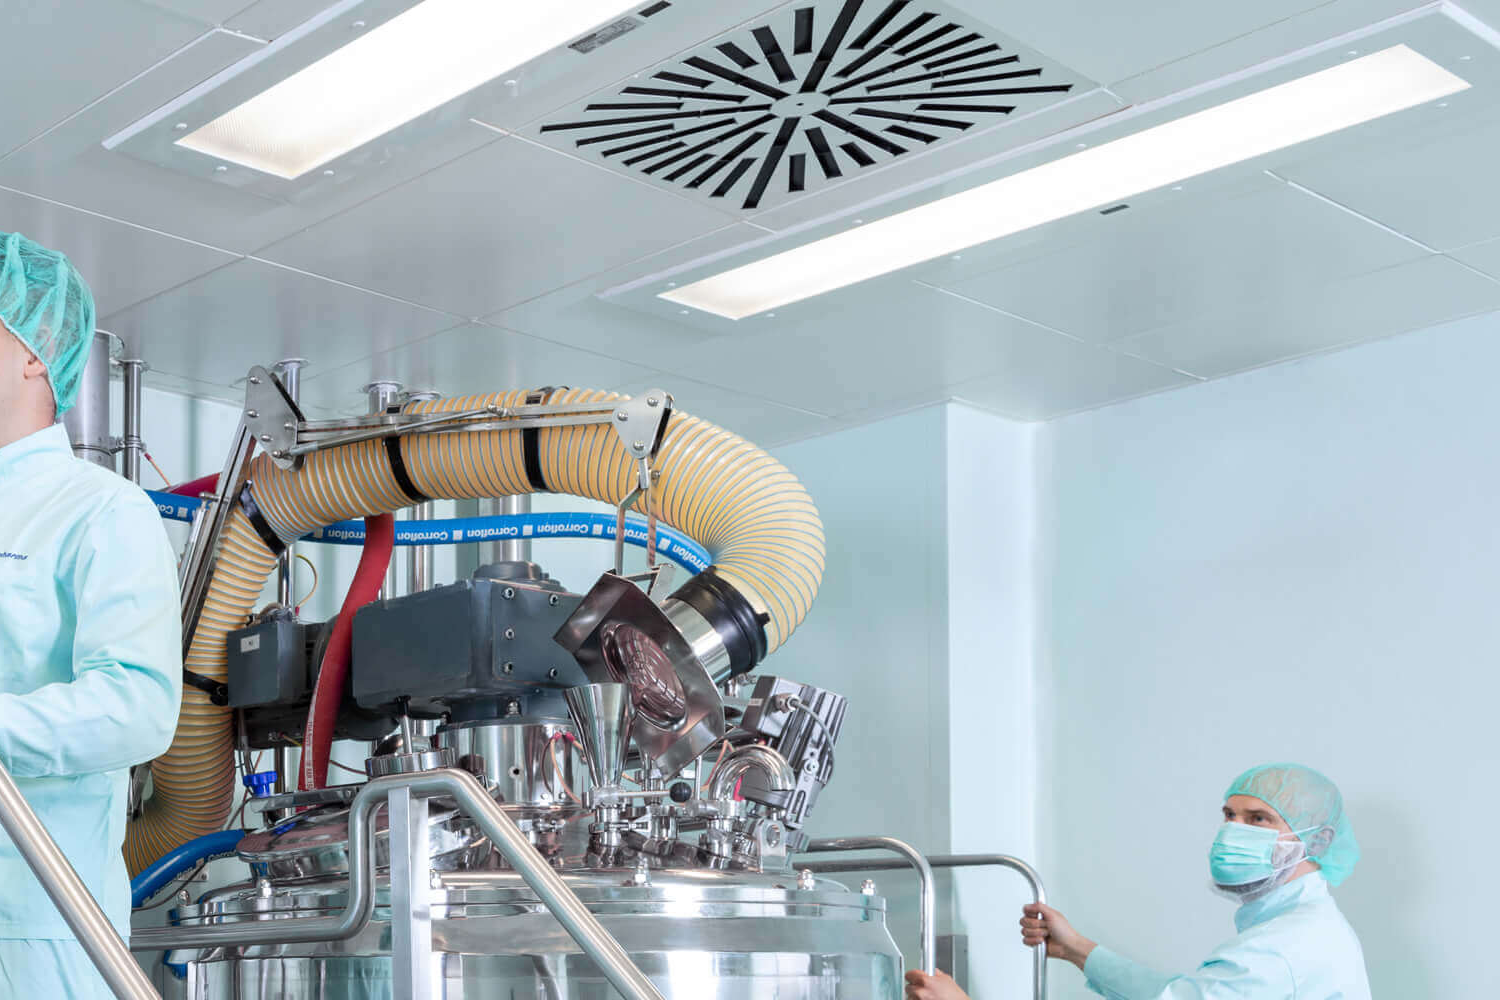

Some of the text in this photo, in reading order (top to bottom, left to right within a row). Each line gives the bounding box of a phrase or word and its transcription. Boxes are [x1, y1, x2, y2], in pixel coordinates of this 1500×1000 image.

[327, 529, 367, 540] rroflon
[467, 526, 518, 538] Corroflon
[537, 524, 589, 534] Corroflon
[396, 531, 449, 542] Corroflon
[672, 544, 709, 571] orroflon
